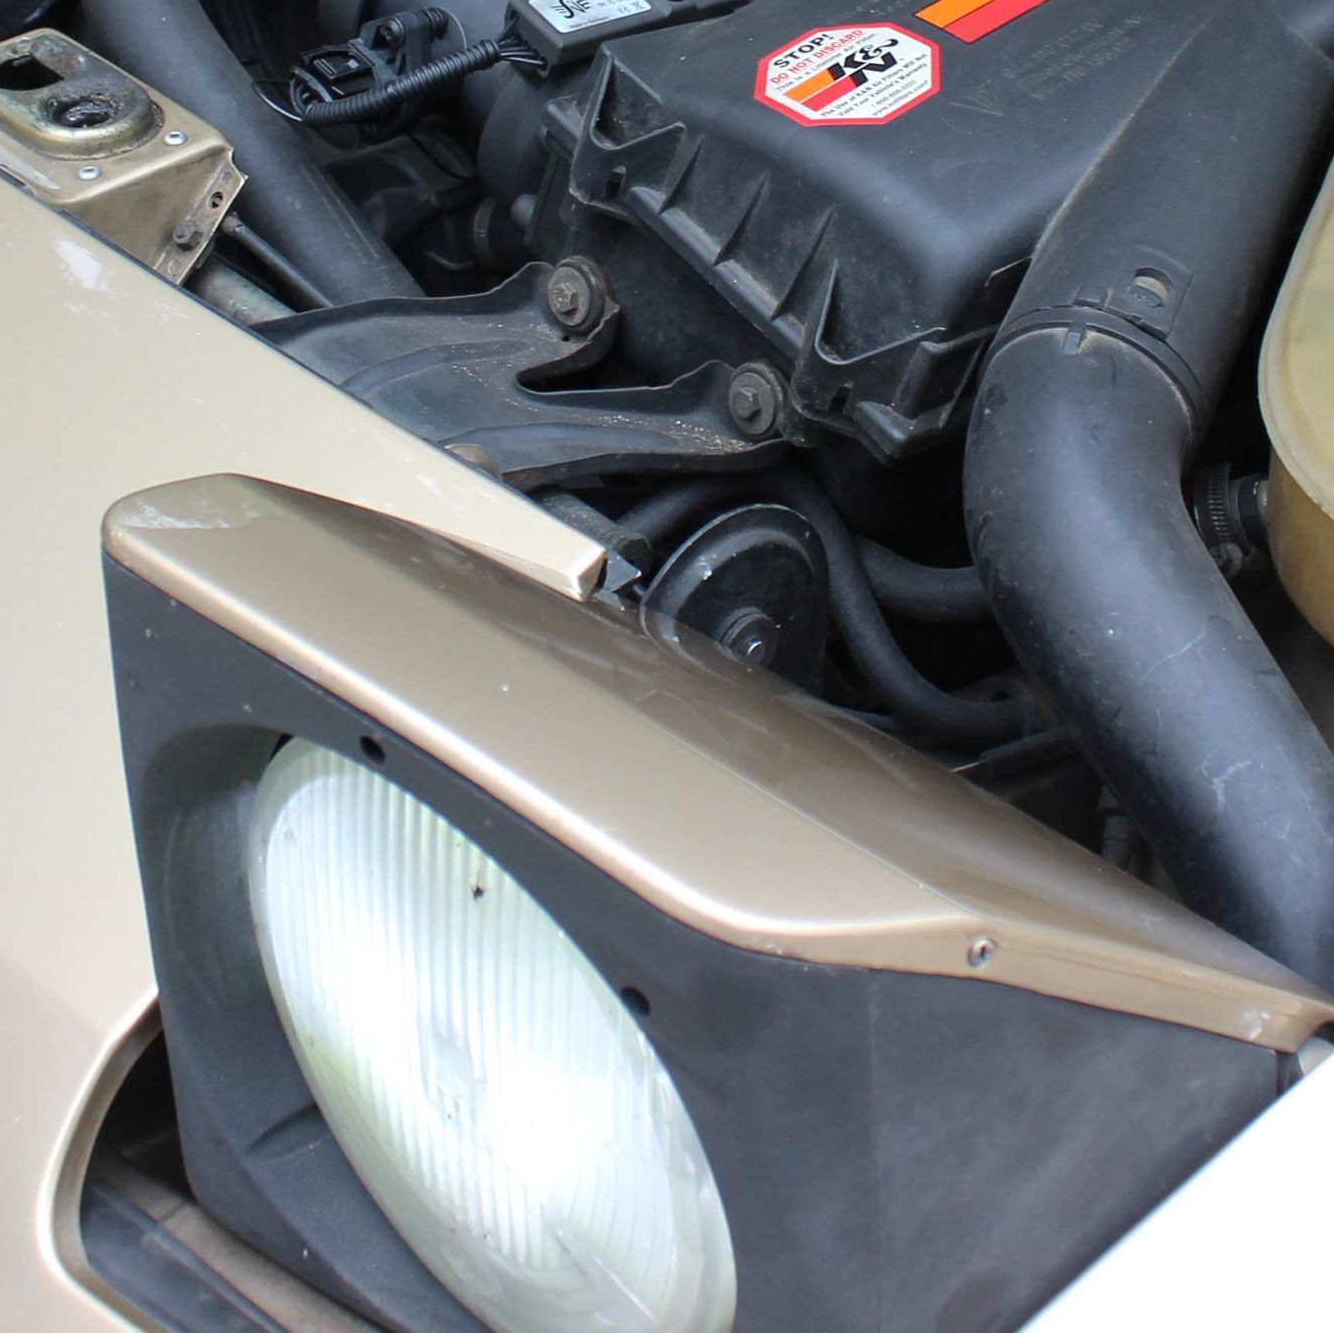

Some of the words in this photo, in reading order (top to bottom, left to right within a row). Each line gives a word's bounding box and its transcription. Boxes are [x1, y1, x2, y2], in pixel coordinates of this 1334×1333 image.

[770, 73, 789, 84] DO
[789, 57, 814, 73] NOT
[814, 29, 863, 59] DISCARD
[774, 33, 834, 68] STOP!
[827, 39, 899, 87] K&N
